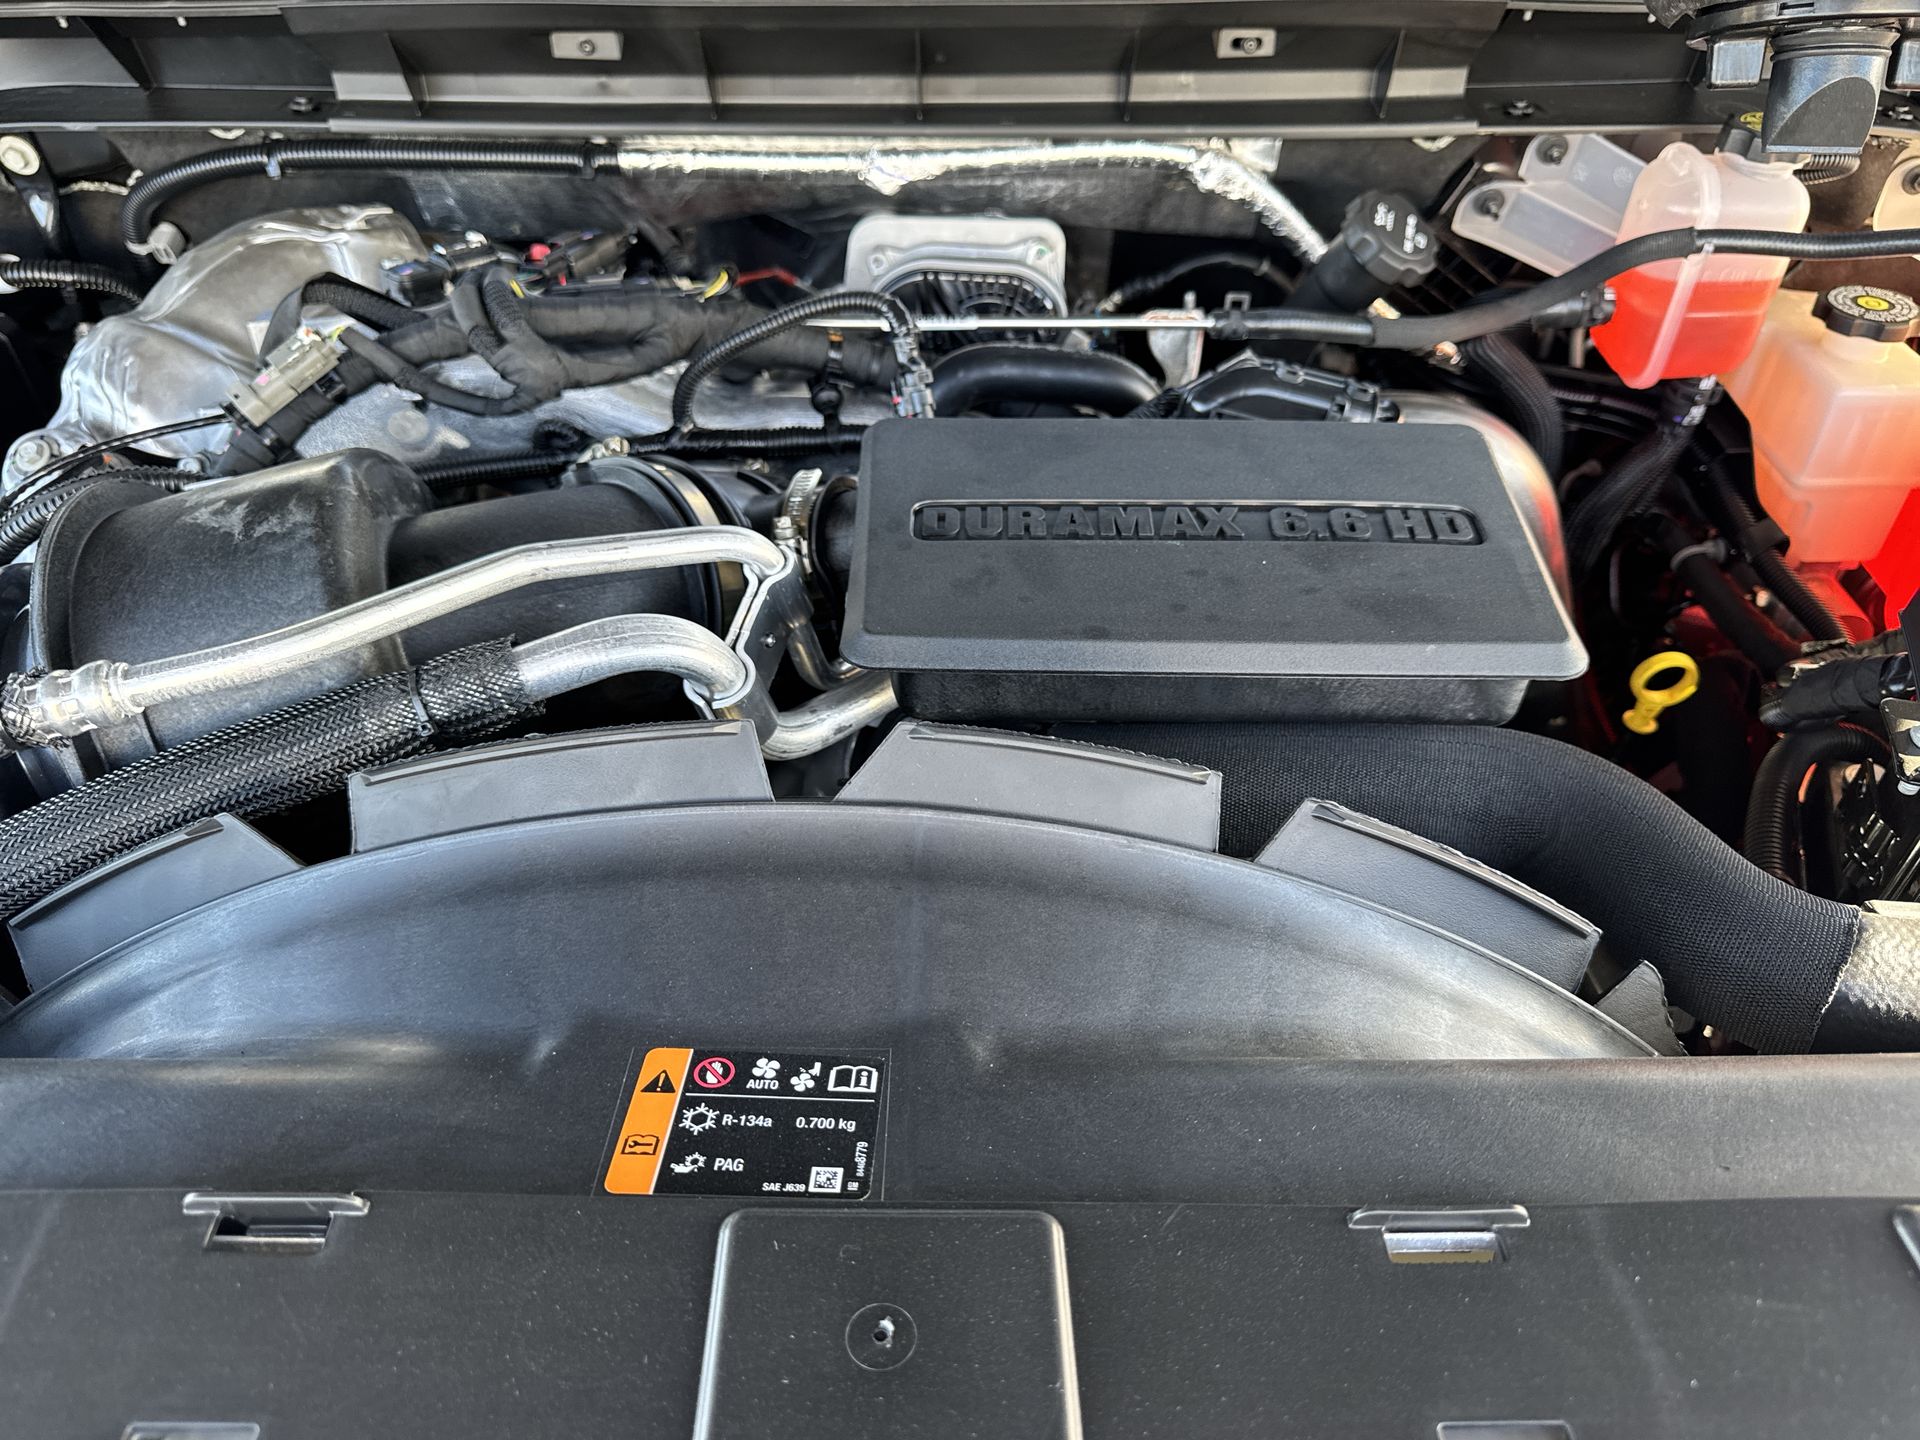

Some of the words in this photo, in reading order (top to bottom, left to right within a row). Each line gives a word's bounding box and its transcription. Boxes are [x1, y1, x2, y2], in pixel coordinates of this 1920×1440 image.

[922, 506, 1244, 537] DURAMAX
[1269, 507, 1372, 539] 6.6
[1386, 509, 1474, 540] HD
[746, 1079, 779, 1090] AUTO
[722, 1114, 773, 1127] R-134a
[796, 1116, 835, 1130] 0.700
[838, 1118, 856, 1132] kg
[713, 1158, 745, 1172] PAG
[762, 1182, 781, 1192] SAE
[782, 1182, 806, 1193] J639
